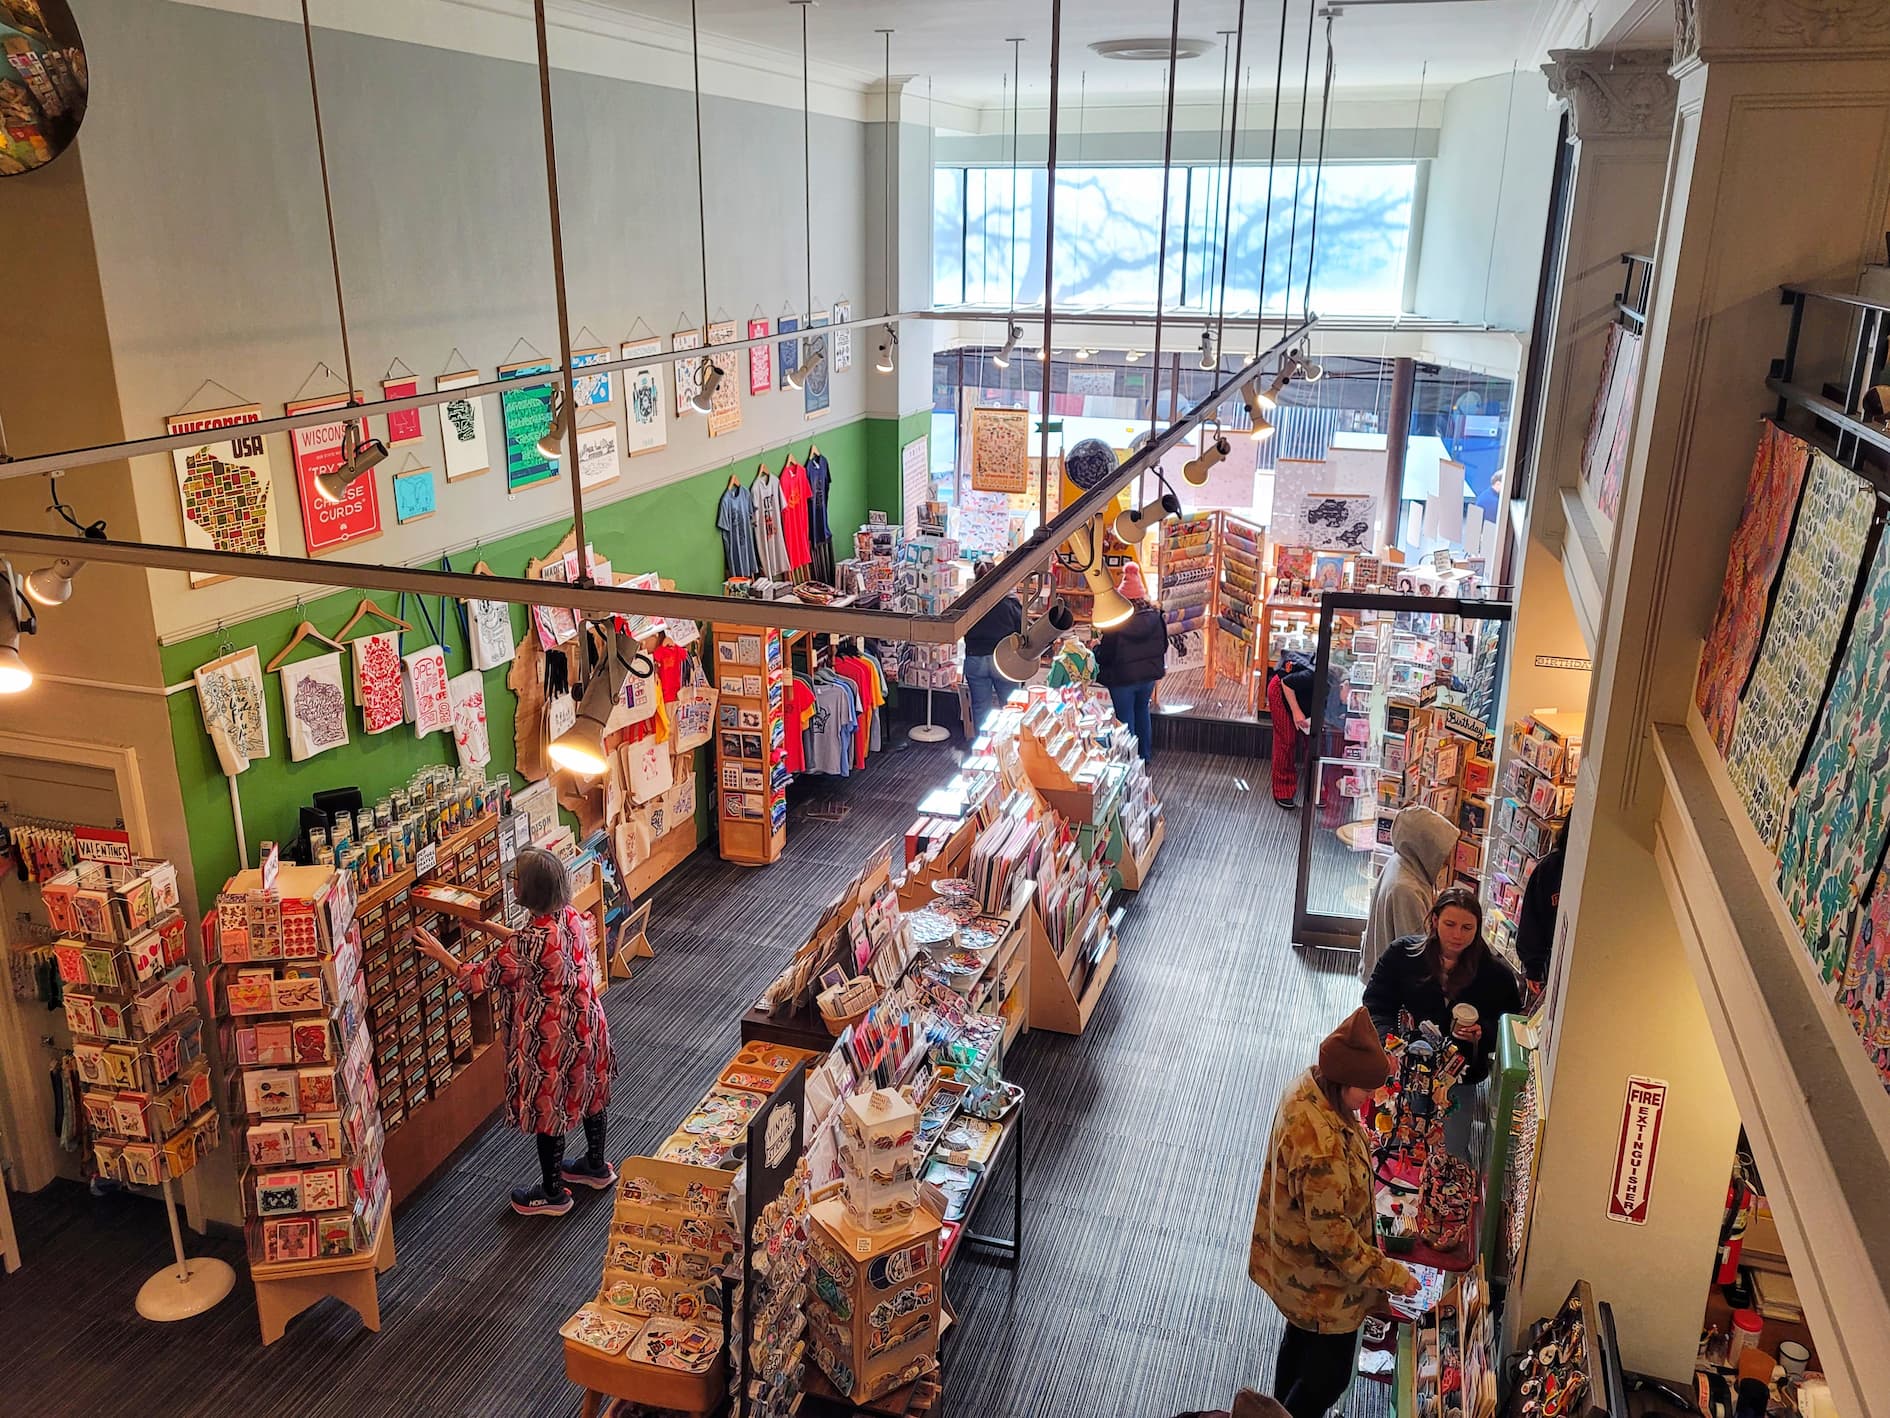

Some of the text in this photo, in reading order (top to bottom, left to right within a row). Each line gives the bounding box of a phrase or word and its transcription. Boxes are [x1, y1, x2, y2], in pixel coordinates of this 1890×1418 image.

[231, 435, 264, 459] USA
[301, 425, 348, 448] WISCONS
[413, 662, 433, 681] OPE
[1447, 711, 1484, 738] Birthday
[78, 841, 128, 861] VALENTINES
[1630, 1089, 1661, 1107] FIRE
[767, 1111, 793, 1142] VINYL
[767, 1124, 794, 1162] STICKERS
[1624, 1106, 1649, 1210] EXTINGUISHER
